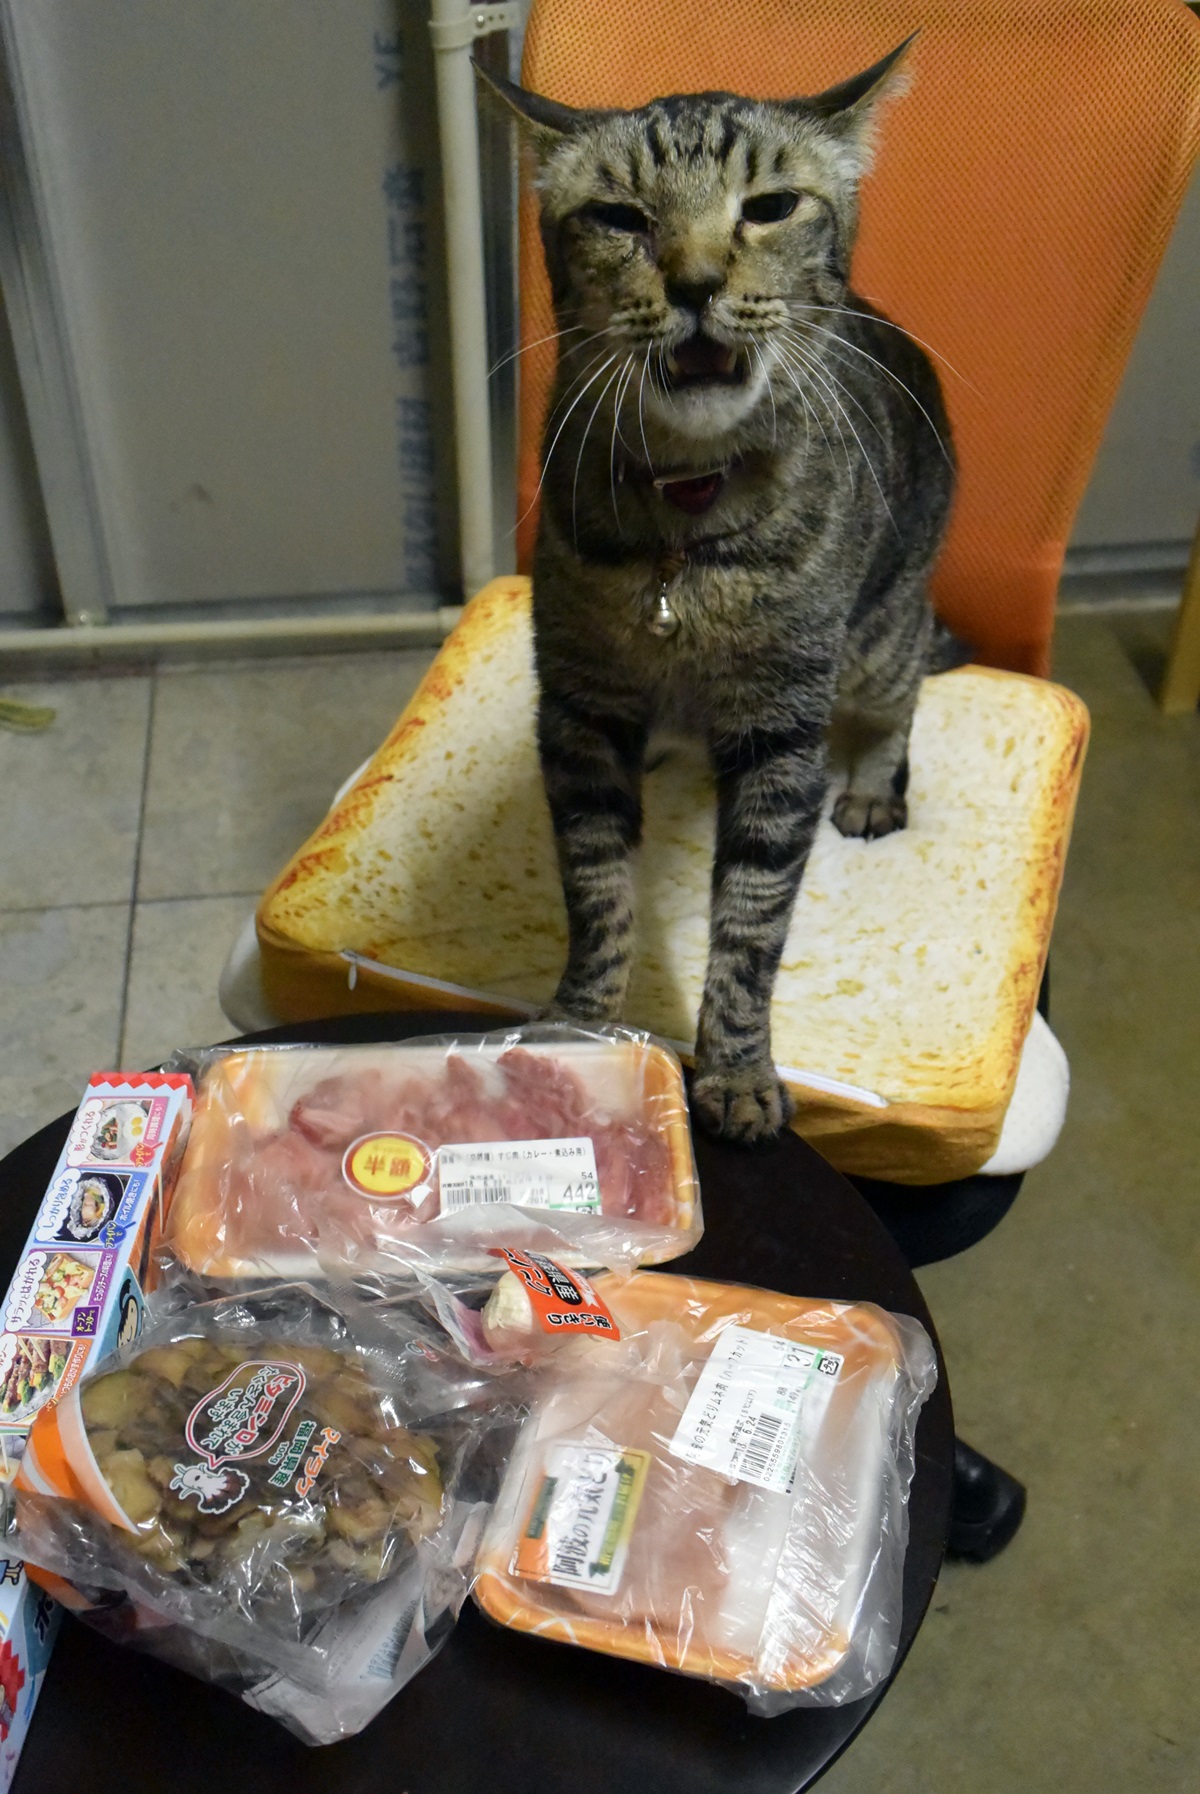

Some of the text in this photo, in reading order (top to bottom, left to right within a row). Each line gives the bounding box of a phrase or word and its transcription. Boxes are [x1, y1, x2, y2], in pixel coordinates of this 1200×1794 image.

[363, 1155, 411, 1178] 半額
[580, 1171, 594, 1180] 54
[43, 1177, 73, 1228] しっかり包める
[562, 1182, 597, 1201] 442
[105, 1221, 117, 1248] フライパン
[11, 1258, 41, 1324] サラッとはがれる
[76, 1310, 87, 1332] オーブン
[547, 1313, 613, 1330] 使いきり
[776, 1386, 788, 1396] 88
[201, 1366, 280, 1449] たくさん含まれて
[208, 1388, 244, 1422] います
[226, 1375, 297, 1455] ビタミンDが
[268, 1420, 317, 1488] 福岡県産
[269, 1441, 289, 1465] 100g
[295, 1427, 341, 1498] マイタケ
